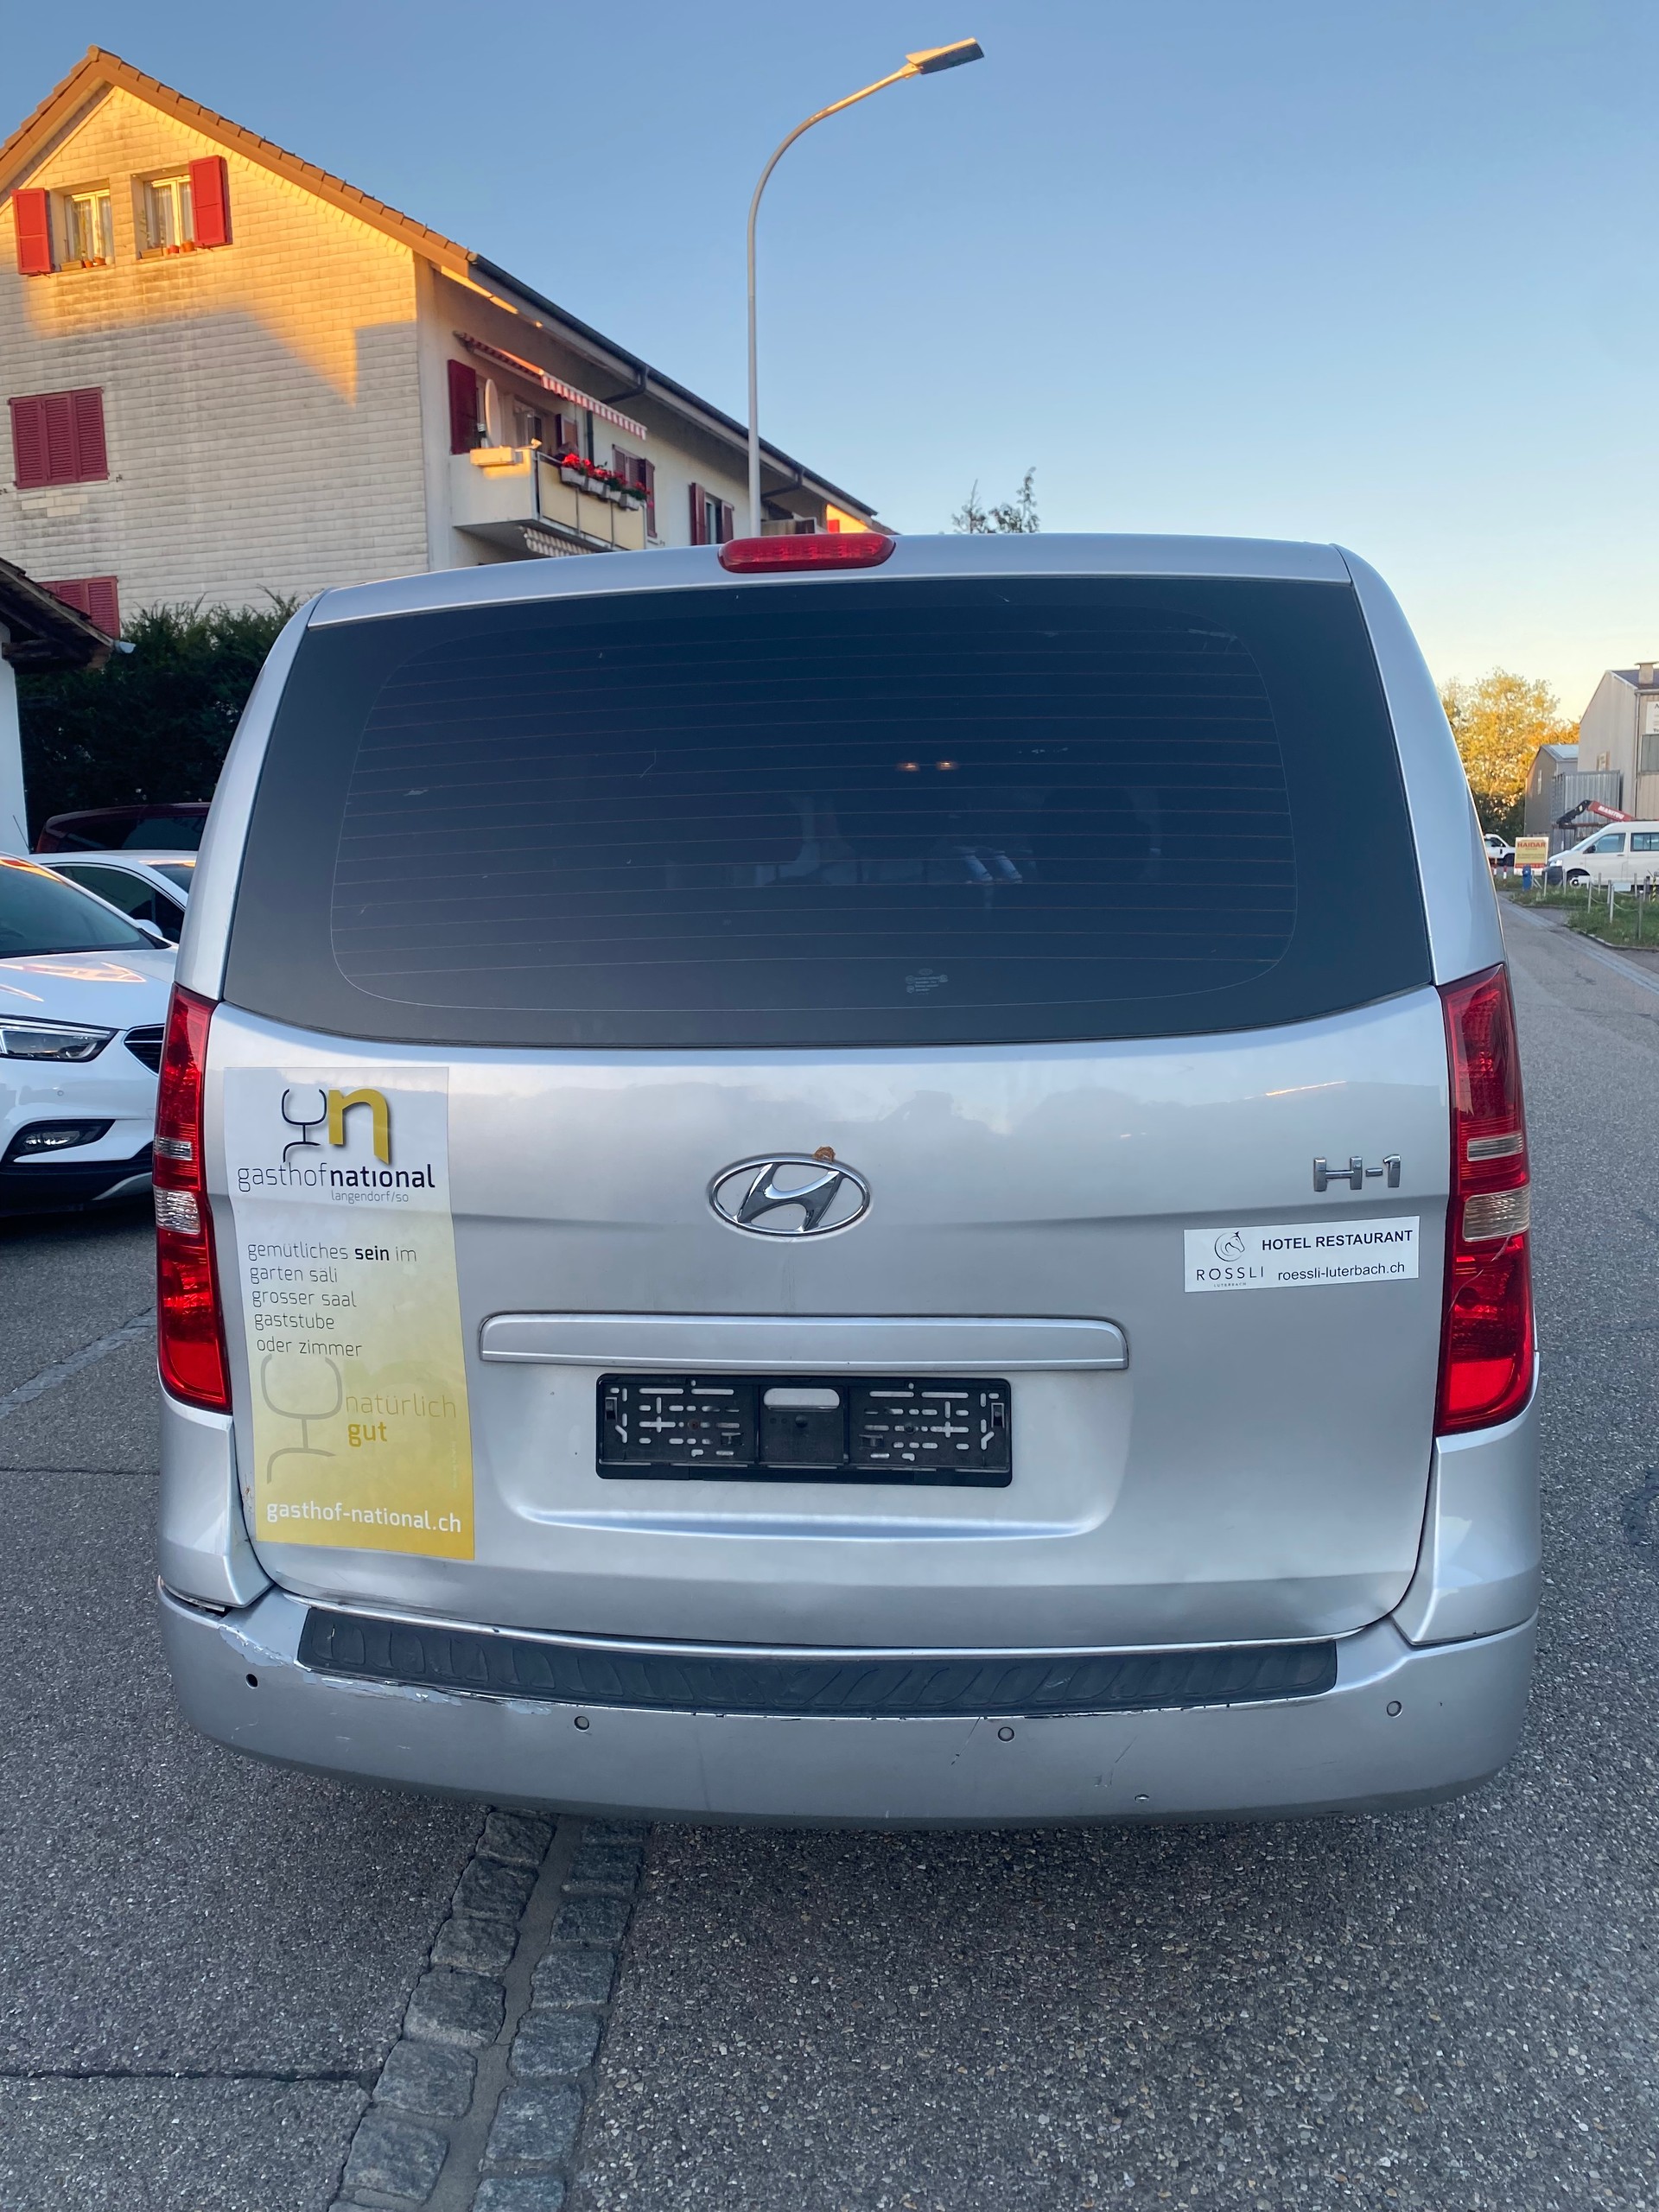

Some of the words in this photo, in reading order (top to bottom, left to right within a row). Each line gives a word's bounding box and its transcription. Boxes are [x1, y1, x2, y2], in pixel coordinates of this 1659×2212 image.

[1313, 1154, 1401, 1192] H-1
[331, 1190, 409, 1204] langendorf/so
[1262, 1236, 1311, 1251] HOTEL
[1316, 1230, 1413, 1248] RESTAURANT
[247, 1241, 349, 1262] gemütliches
[354, 1245, 390, 1261] sein
[396, 1246, 417, 1262] im
[250, 1266, 303, 1284] garten
[309, 1266, 338, 1283] säli
[1278, 1262, 1405, 1281] roessli-luterbach.ch
[252, 1290, 315, 1307] grosser
[321, 1291, 357, 1307] saal
[254, 1313, 334, 1331] gaststube
[257, 1336, 292, 1353] oder
[299, 1339, 362, 1357] zimmer
[346, 1393, 456, 1418] natürlich
[347, 1421, 387, 1447] gut
[266, 1501, 461, 1533] gasthof-national.ch
